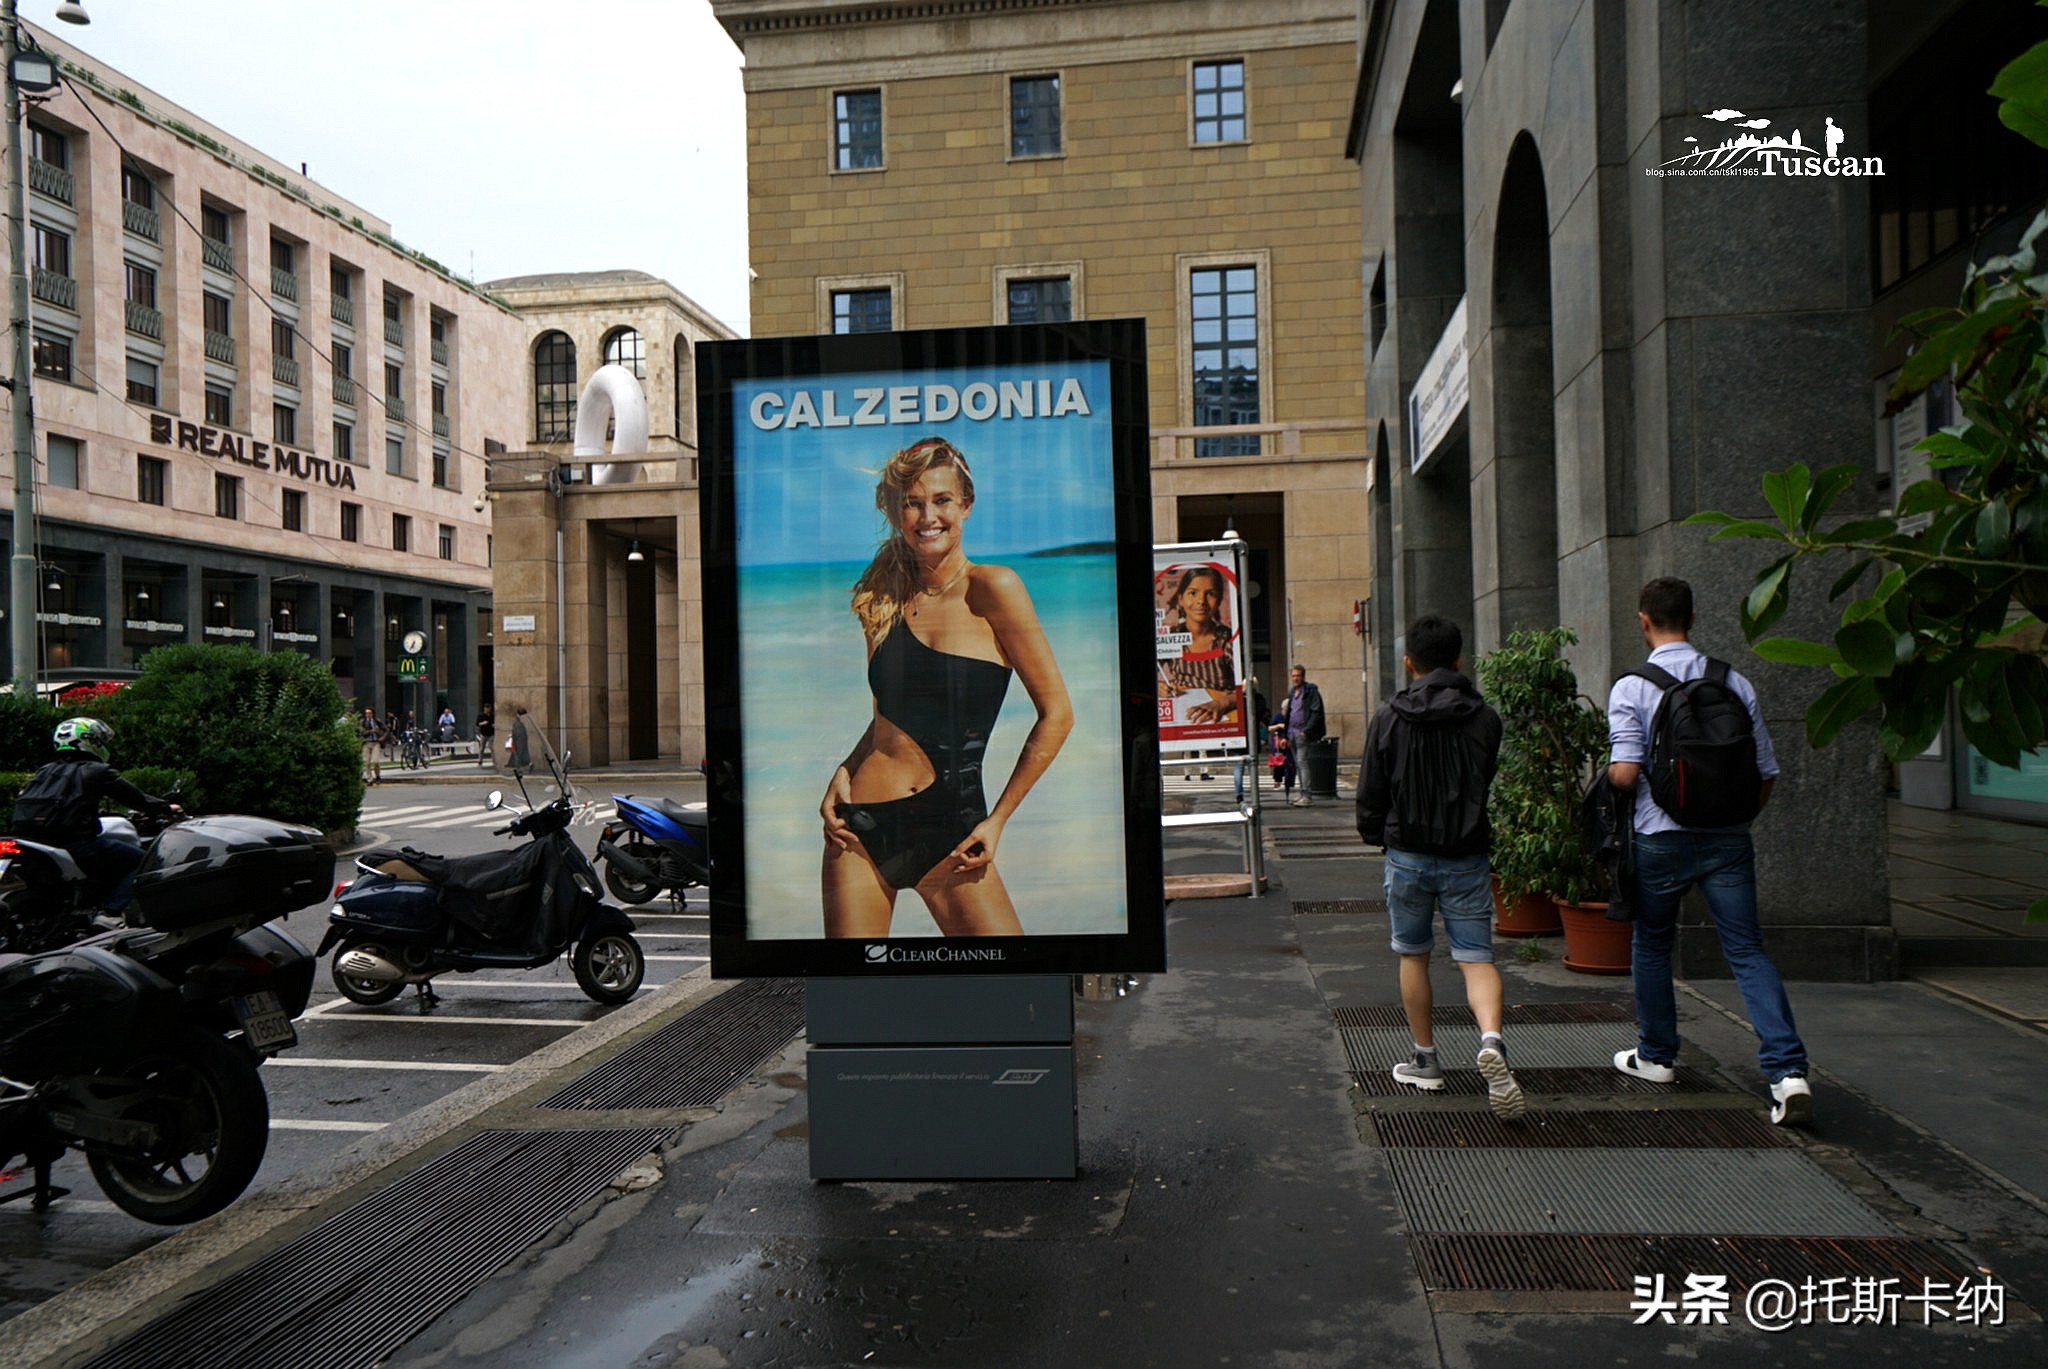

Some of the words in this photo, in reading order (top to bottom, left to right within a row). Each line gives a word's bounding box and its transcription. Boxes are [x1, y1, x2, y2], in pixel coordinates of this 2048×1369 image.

[750, 378, 1091, 431] CALZEDONIA
[178, 420, 270, 470] REALE
[275, 447, 356, 491] MUTUA
[1157, 634, 1191, 645] SALVEZZA
